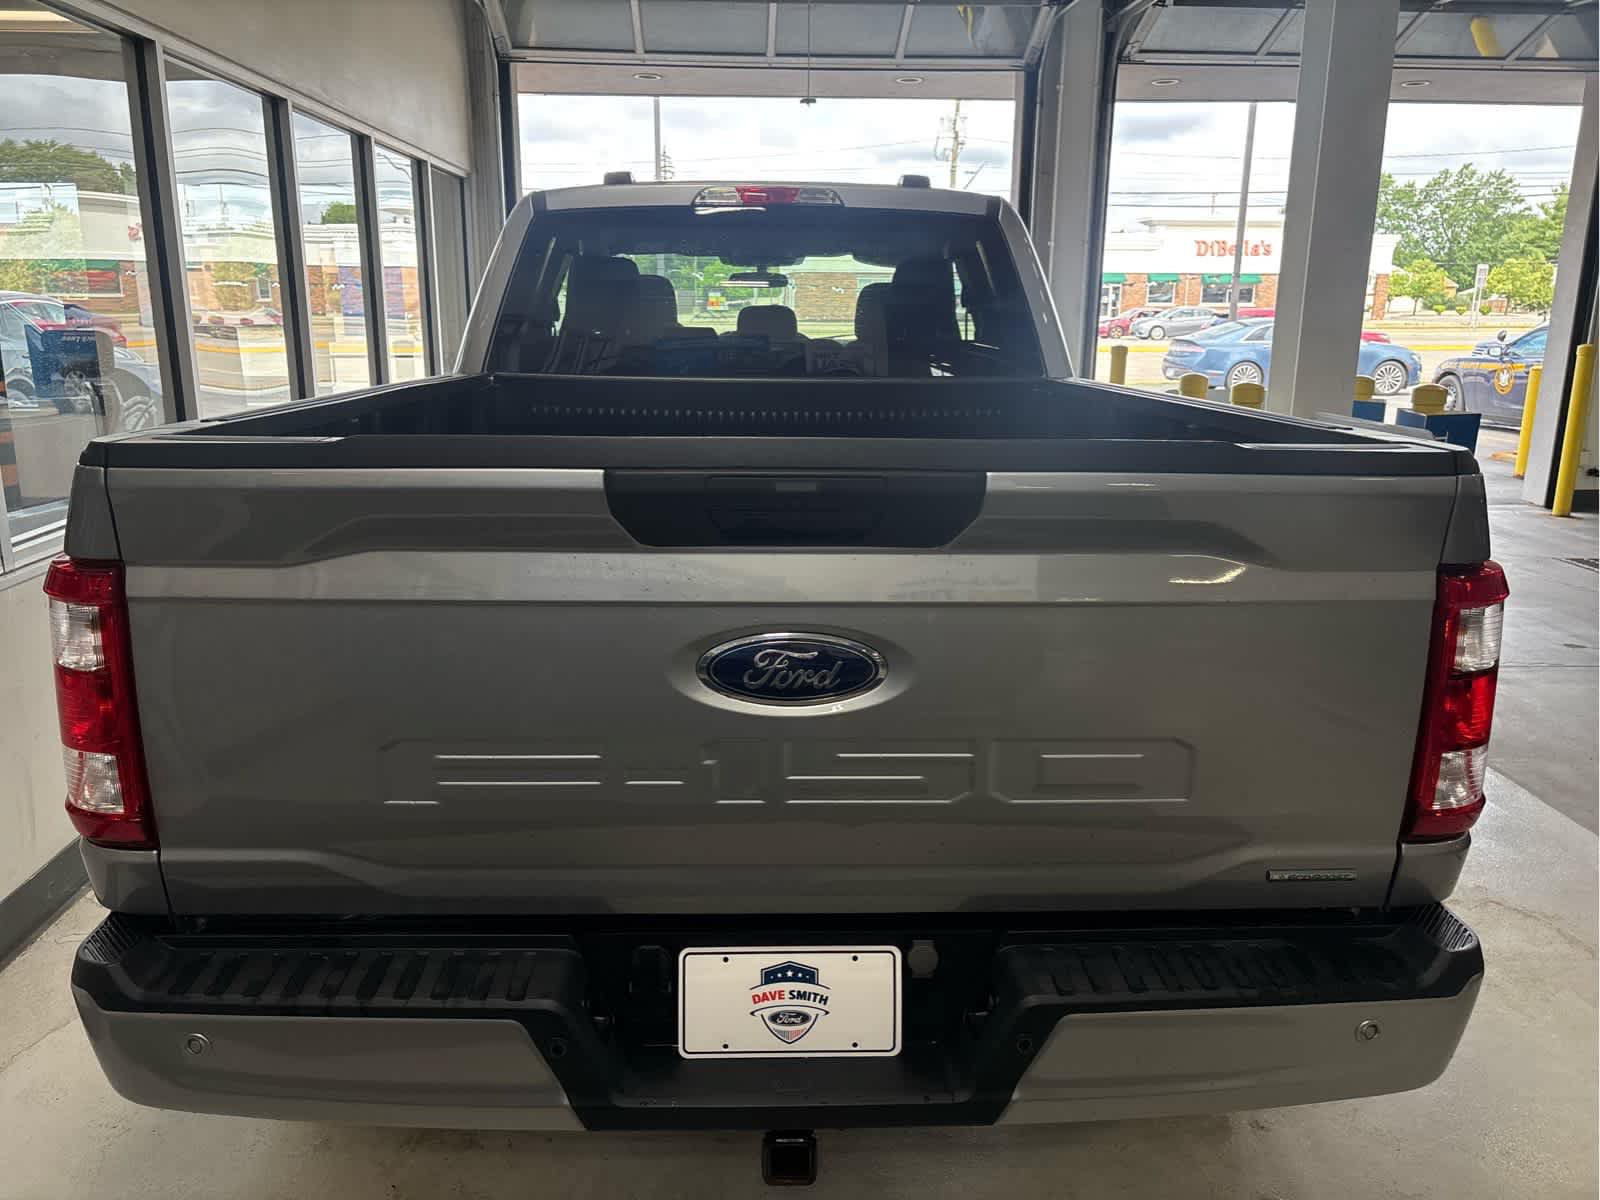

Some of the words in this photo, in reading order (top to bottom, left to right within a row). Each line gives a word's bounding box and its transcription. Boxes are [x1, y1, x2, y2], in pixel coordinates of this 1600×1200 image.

[1194, 240, 1272, 256] DiBela's
[743, 649, 843, 689] Ford
[377, 738, 1193, 804] F-150
[751, 989, 785, 1005] DAVE
[788, 990, 829, 1006] SMITH
[775, 1012, 803, 1025] Ford
